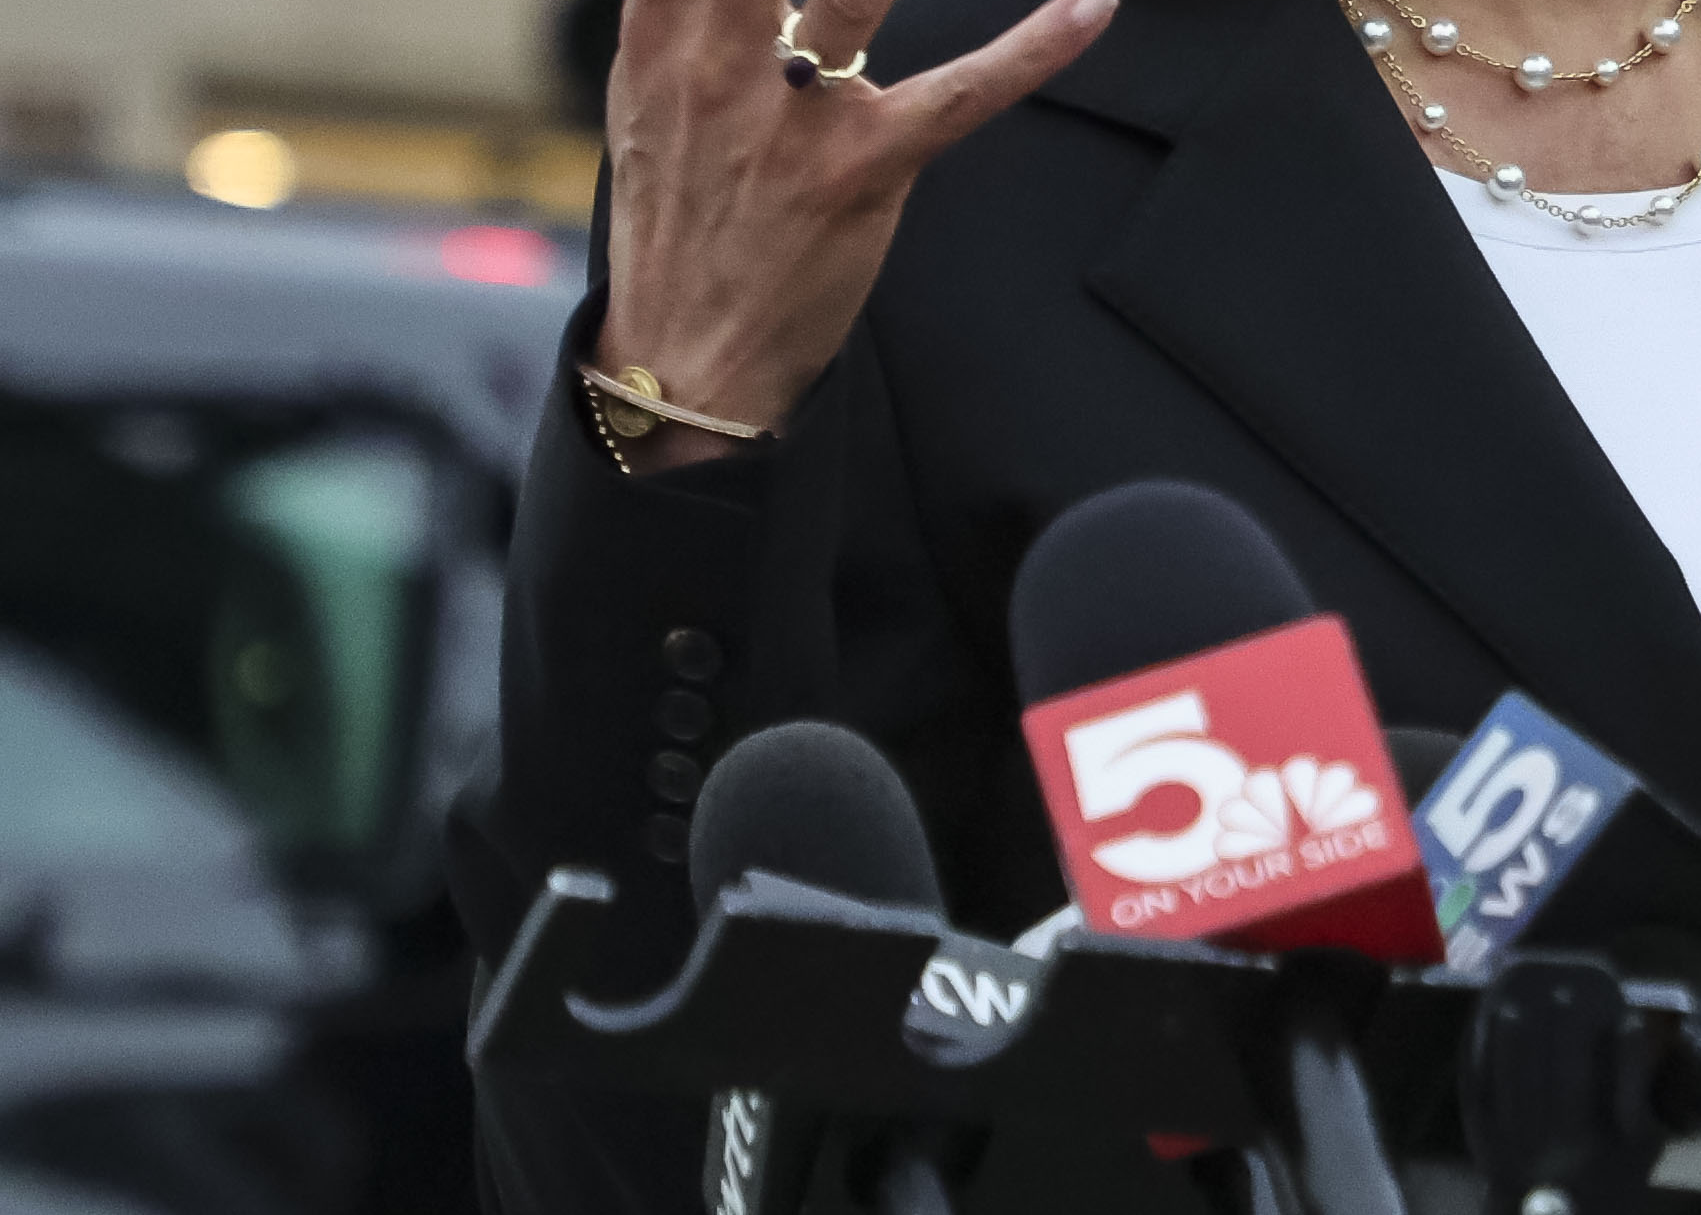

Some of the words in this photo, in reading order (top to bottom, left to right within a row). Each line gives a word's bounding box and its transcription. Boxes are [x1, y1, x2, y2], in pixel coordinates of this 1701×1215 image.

[1064, 689, 1248, 884] 5
[1426, 725, 1560, 874] 5
[1110, 886, 1178, 929] ON
[1182, 851, 1295, 905] YOUR
[1299, 820, 1389, 870] SIDE
[1446, 785, 1599, 974] EWS
